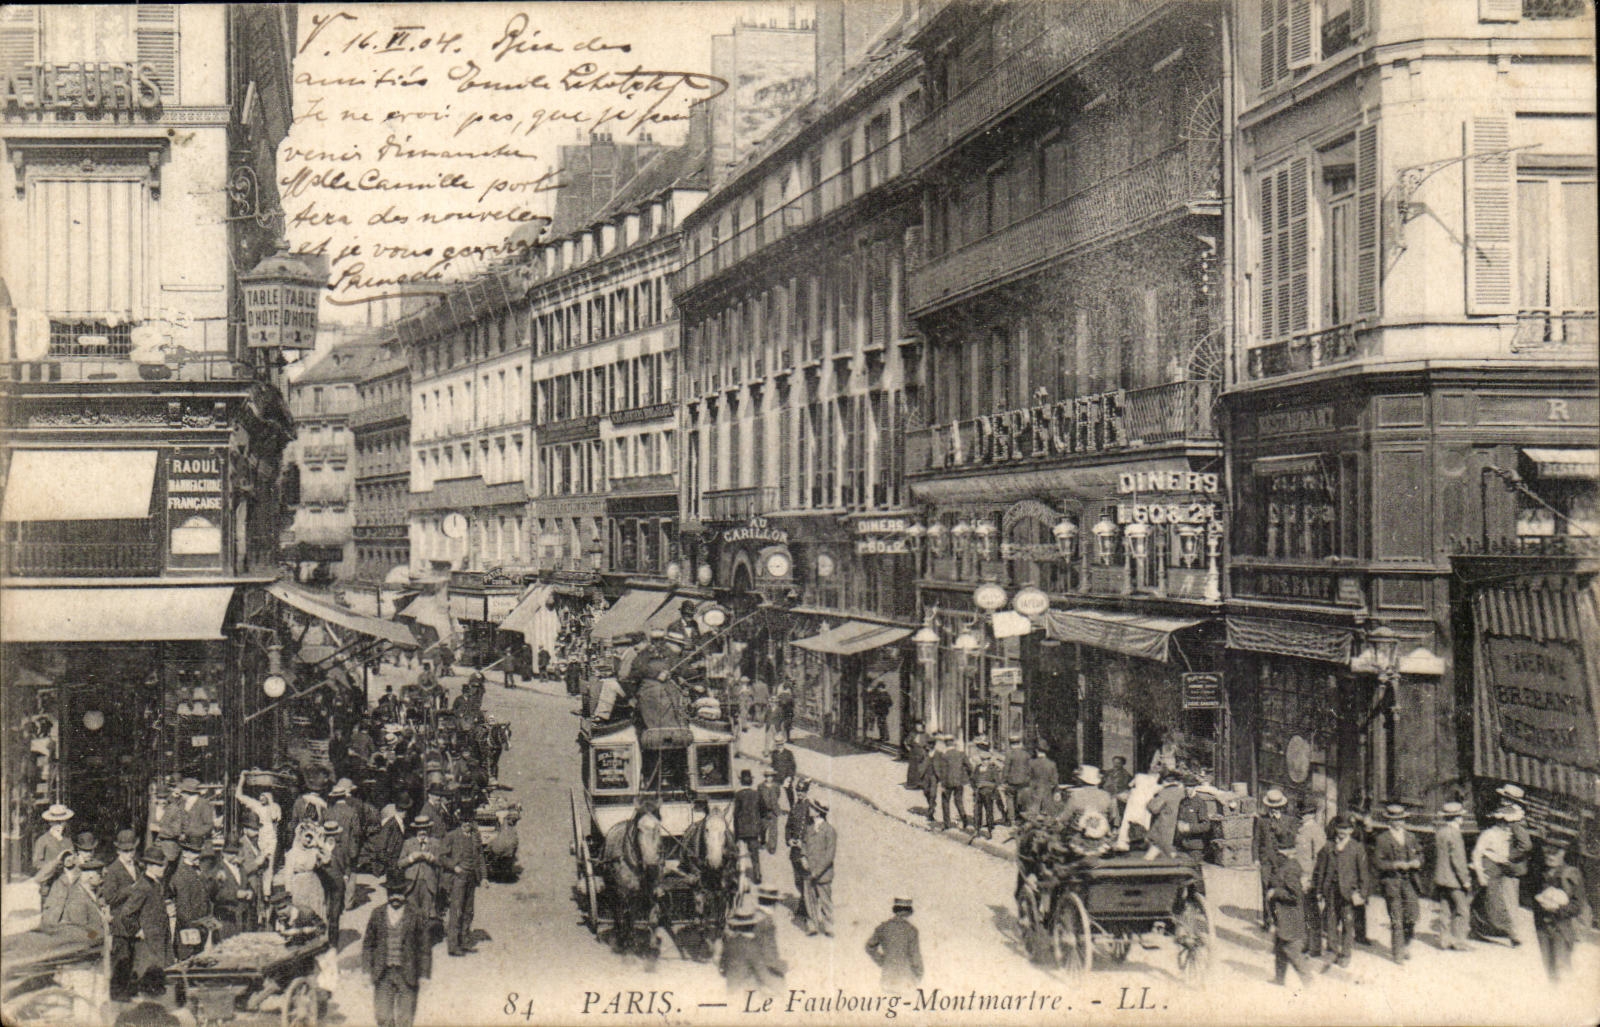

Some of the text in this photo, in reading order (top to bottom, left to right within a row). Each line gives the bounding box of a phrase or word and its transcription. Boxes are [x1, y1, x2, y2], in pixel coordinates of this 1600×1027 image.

[573, 36, 632, 53] des
[341, 109, 373, 121] ne
[284, 144, 362, 162] venir
[358, 168, 475, 191] Camille
[367, 205, 408, 226] des
[299, 238, 333, 258] et
[373, 243, 434, 260] vous
[248, 289, 279, 306] TABLE
[286, 289, 317, 309] TABLE
[1547, 400, 1569, 421] R
[173, 459, 219, 474] RAOUL
[1120, 473, 1217, 493] DINERS
[168, 496, 222, 511] FRANÇAISE
[749, 518, 767, 528] AU
[723, 528, 788, 544] CARILLON
